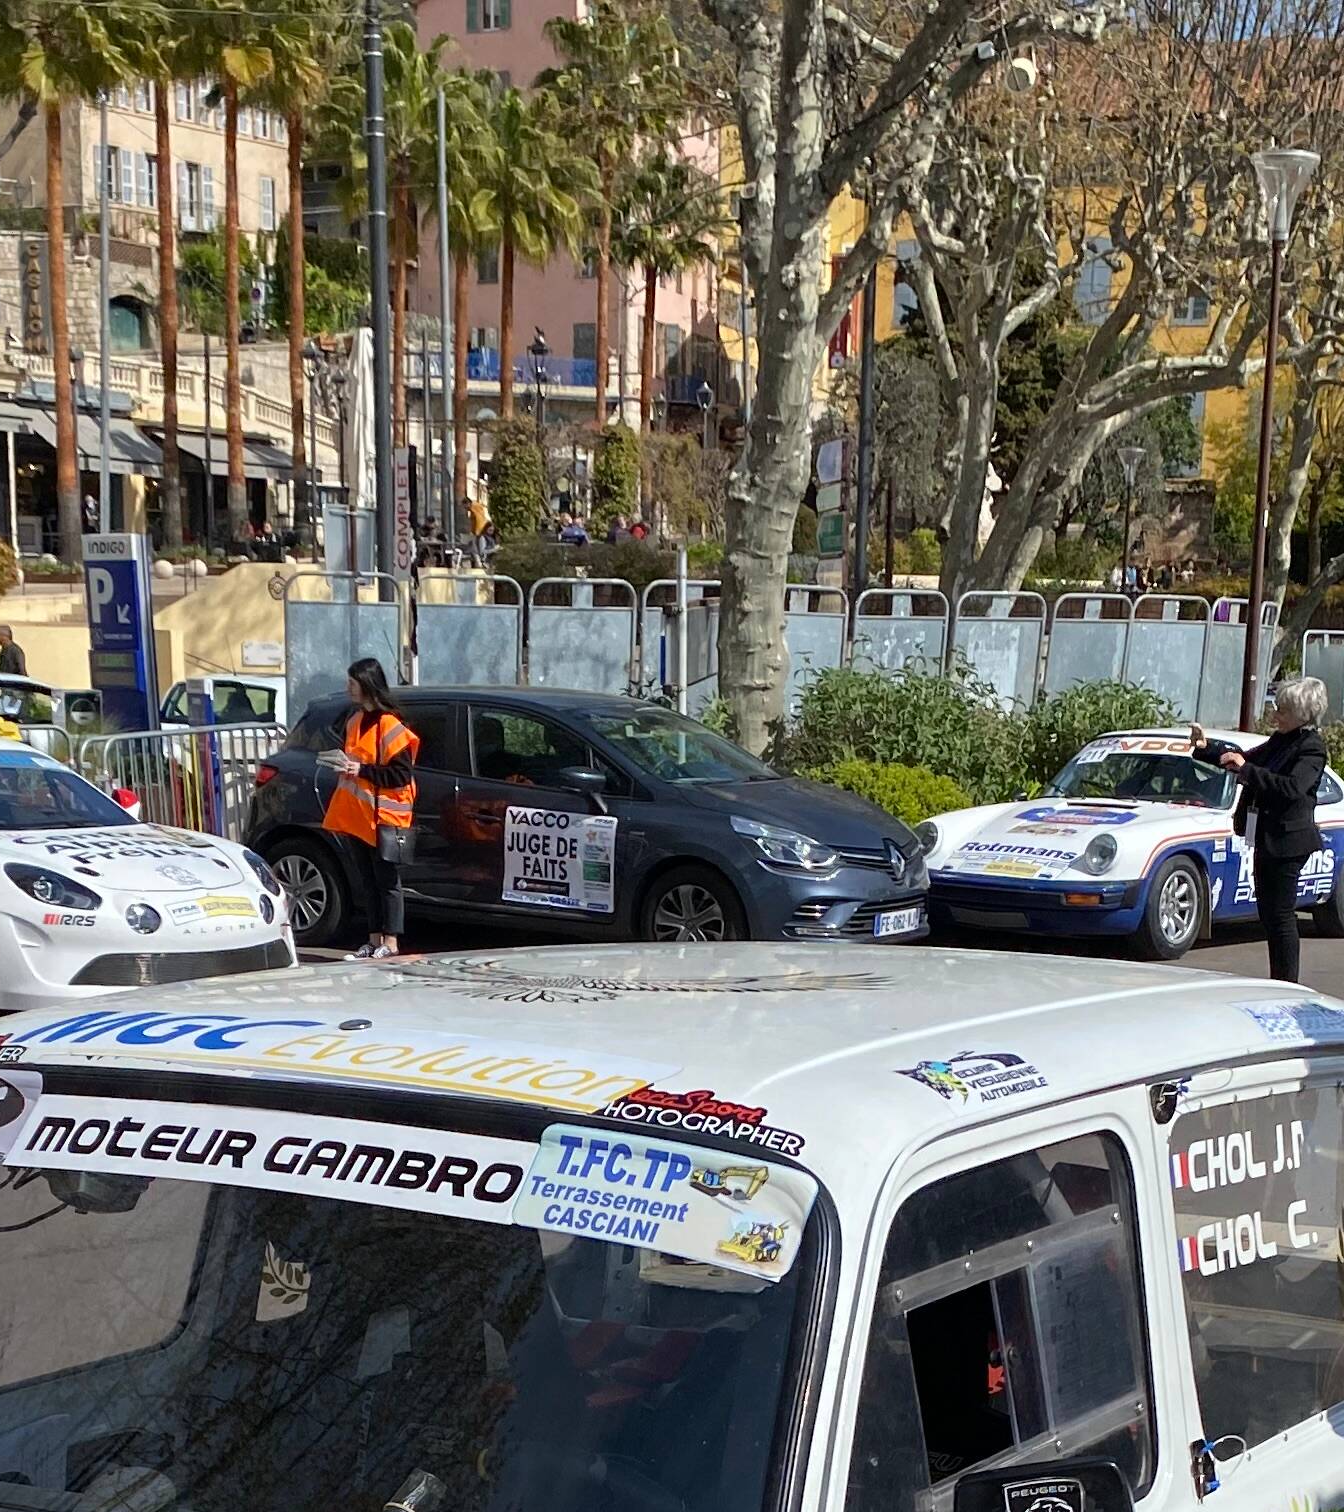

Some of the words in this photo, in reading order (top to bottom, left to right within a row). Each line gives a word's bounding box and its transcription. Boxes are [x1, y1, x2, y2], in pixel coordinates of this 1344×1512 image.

[26, 242, 44, 334] CASINO
[397, 463, 409, 571] COMPLET
[88, 542, 125, 555] INDIGO
[88, 566, 114, 624] P
[510, 809, 570, 830] YACCO
[506, 831, 552, 857] JUGE
[556, 836, 579, 860] DE
[522, 855, 569, 881] FAITS
[60, 913, 97, 928] RRS
[12, 1009, 326, 1052] MGC
[262, 1030, 653, 1100] Evolution
[604, 1101, 804, 1155] HOTOGRAPHER
[265, 1135, 525, 1203] GAMBRO
[556, 1134, 692, 1193] T.FC.TP
[1187, 1129, 1267, 1193] CHOL
[529, 1175, 690, 1223] Terrassement
[543, 1203, 660, 1243] CASCIANI
[1196, 1210, 1278, 1277] CHOL
[1287, 1199, 1318, 1250] C.
[1011, 1484, 1075, 1499] PEUGEOT
